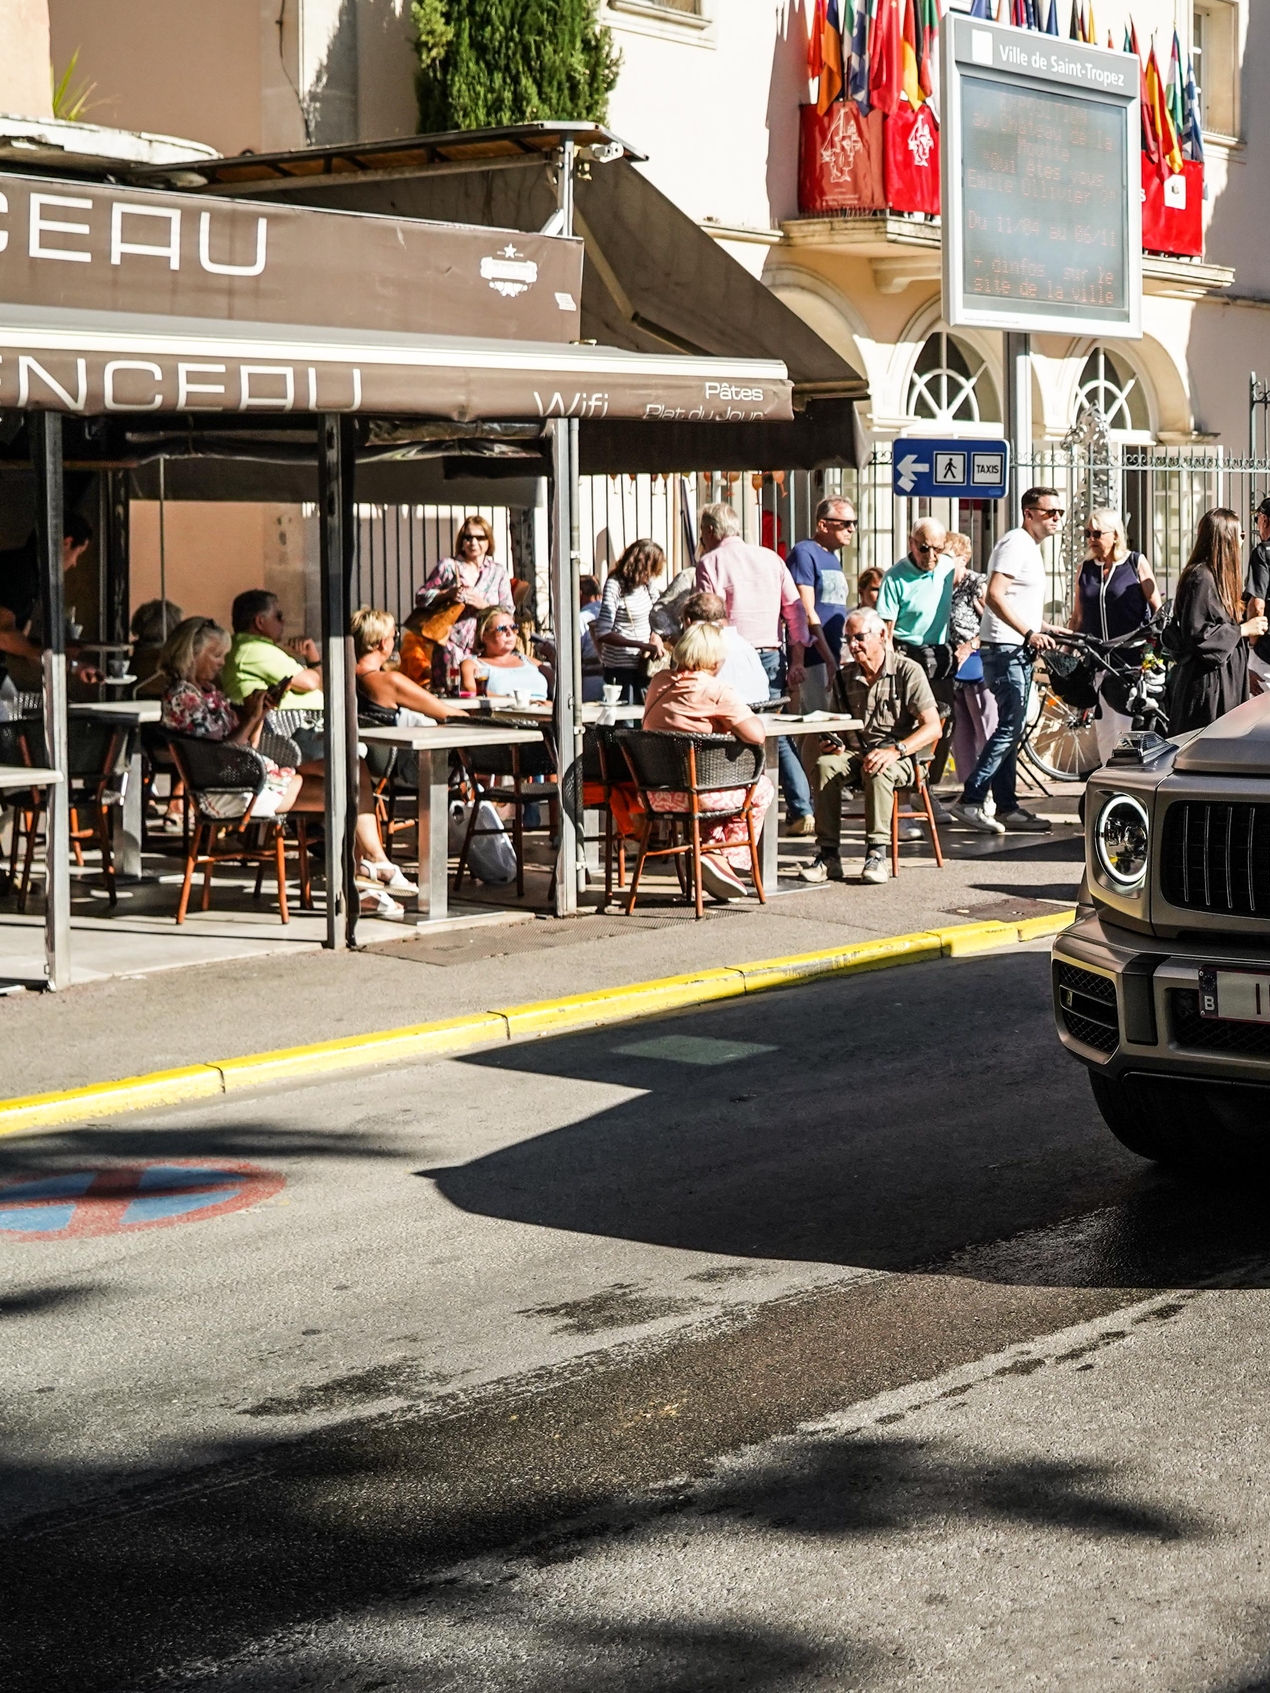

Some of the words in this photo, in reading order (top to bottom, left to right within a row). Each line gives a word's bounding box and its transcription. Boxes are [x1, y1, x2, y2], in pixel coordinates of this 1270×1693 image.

[999, 44, 1028, 66] Ville
[1031, 51, 1047, 70] de
[1050, 55, 1125, 87] Saint-Tropez
[967, 209, 988, 231] Du
[0, 191, 268, 277] EAU
[0, 355, 362, 412] NCEAU
[705, 381, 764, 402] Pâtes
[533, 391, 609, 419] Wifi
[976, 464, 999, 474] TAXIS
[1204, 995, 1215, 1011] B
